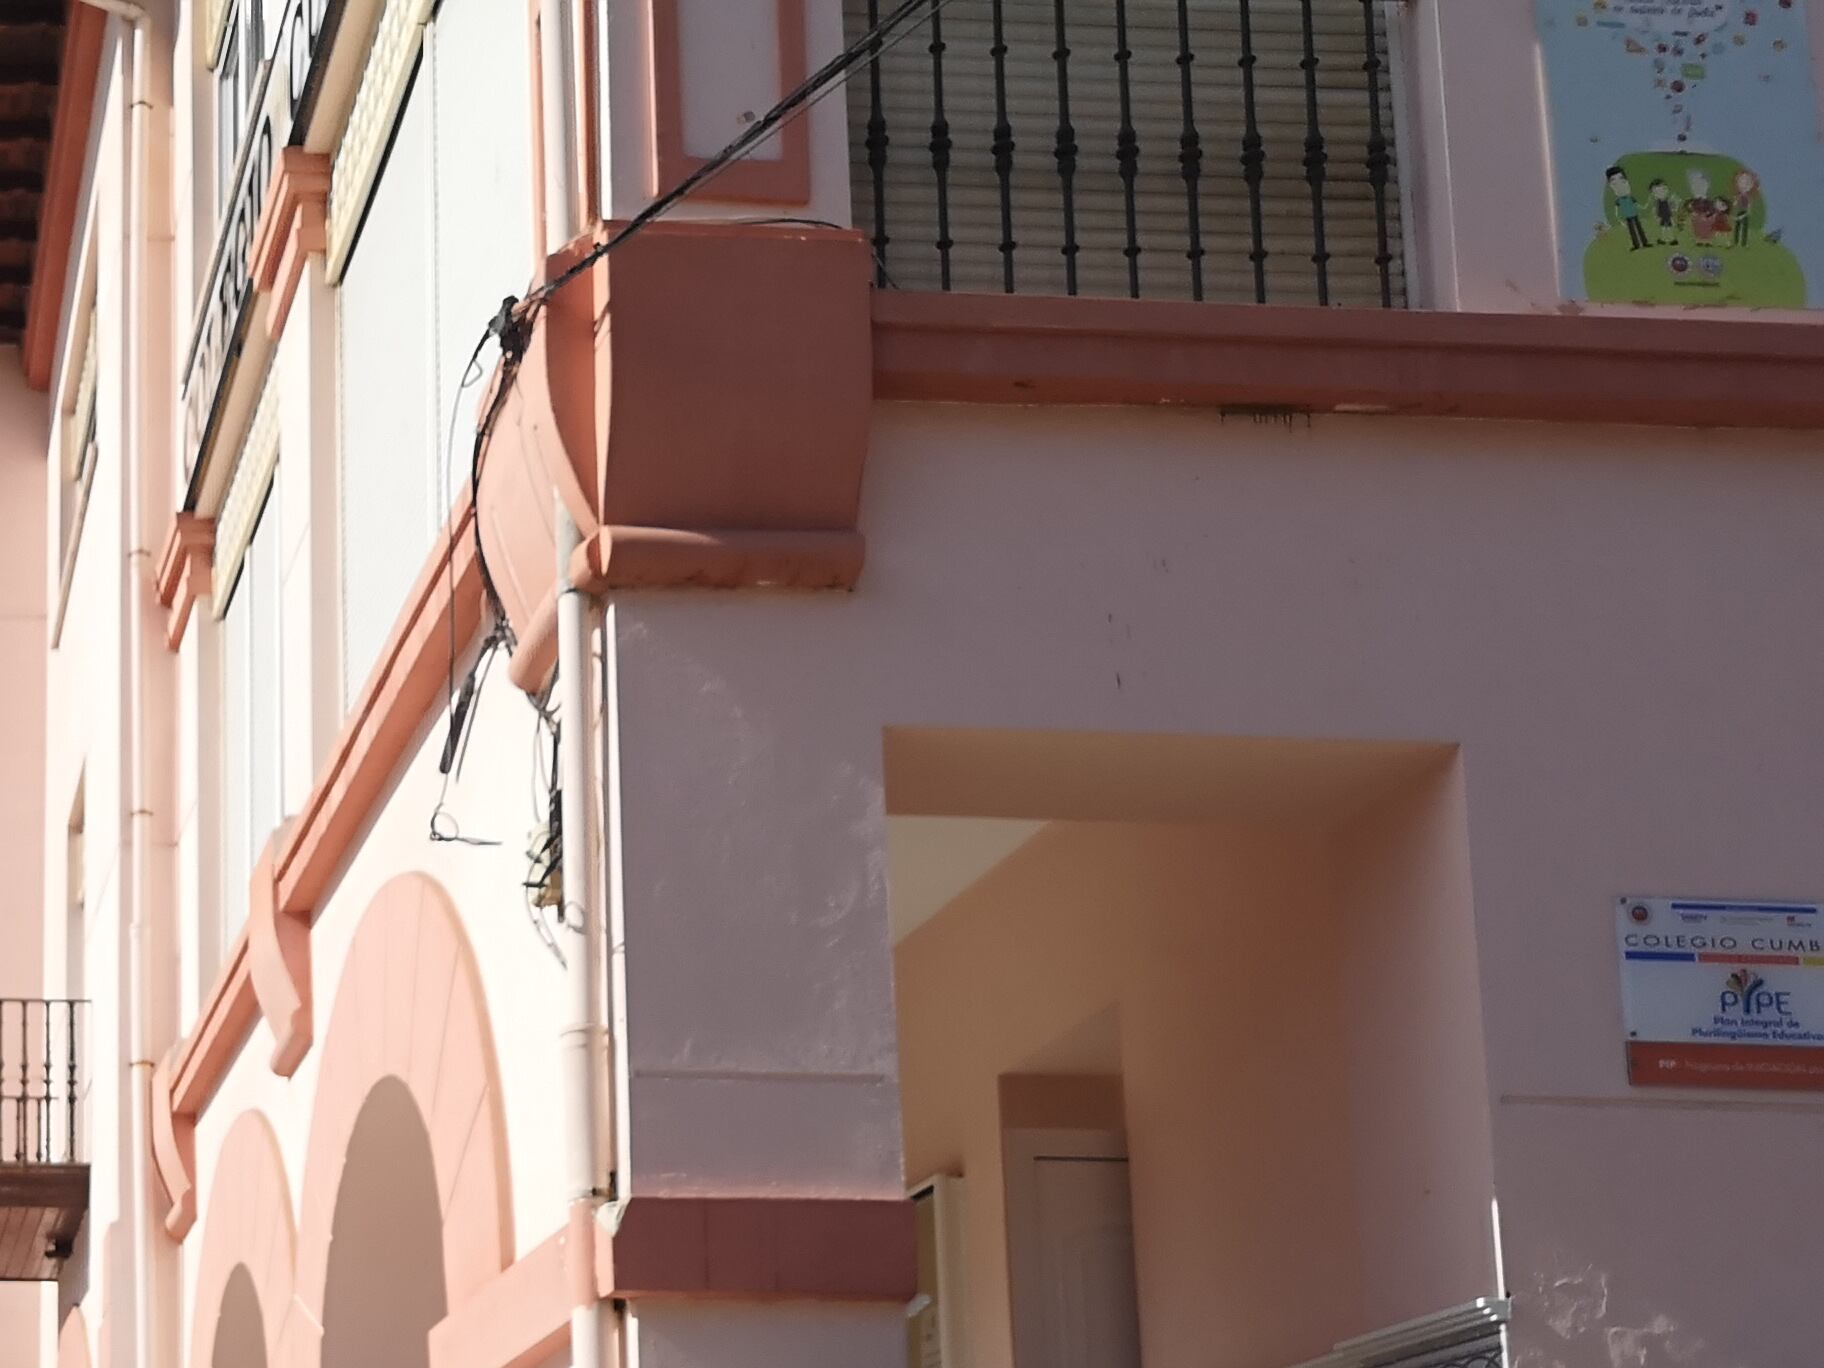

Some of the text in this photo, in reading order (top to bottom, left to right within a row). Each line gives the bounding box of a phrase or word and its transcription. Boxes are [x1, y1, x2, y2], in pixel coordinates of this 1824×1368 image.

[1624, 934, 1737, 949] COLEGIO
[1713, 1015, 1800, 1029] Plan Integral de
